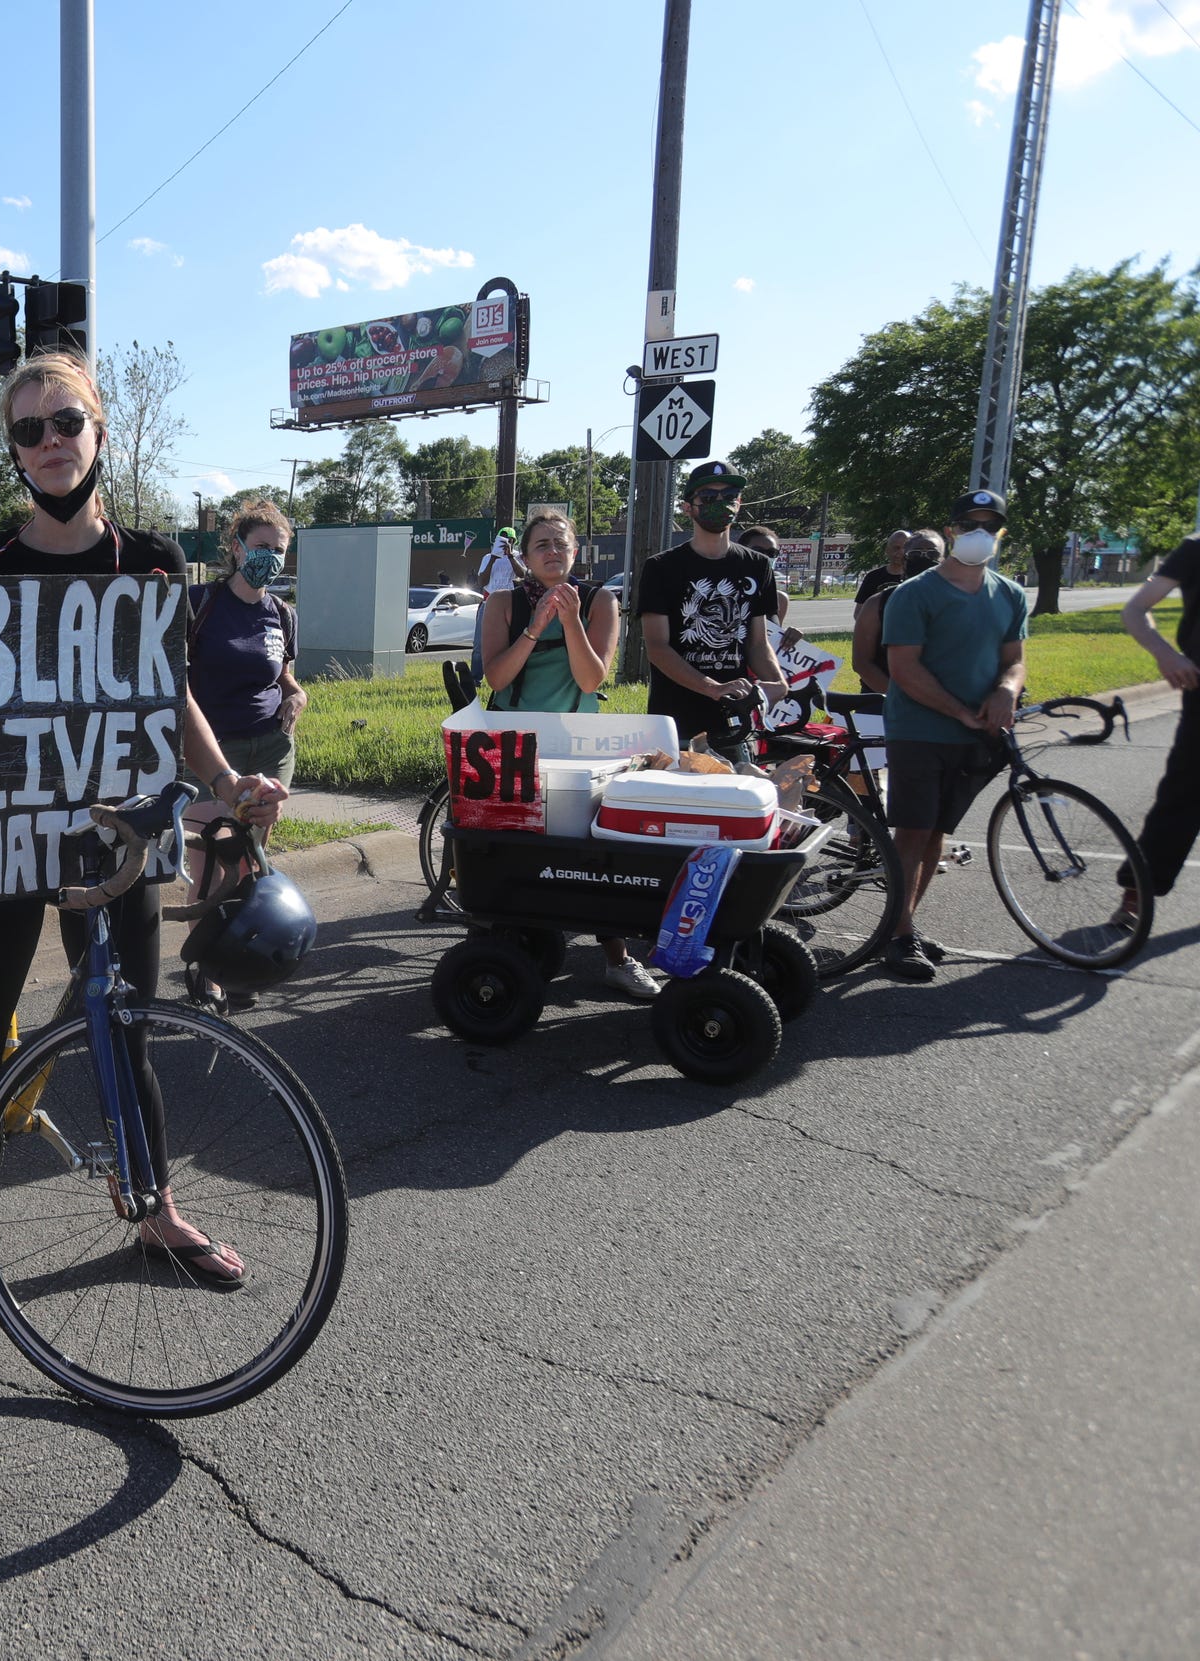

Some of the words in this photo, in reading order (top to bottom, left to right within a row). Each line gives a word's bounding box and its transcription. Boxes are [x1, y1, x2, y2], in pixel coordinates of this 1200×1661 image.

[297, 368, 311, 380] Up
[313, 367, 323, 376] to
[325, 361, 347, 374] 25%
[349, 358, 364, 370] off
[366, 352, 407, 370] grocery
[409, 348, 438, 361] store
[653, 345, 709, 371] WEST
[297, 379, 329, 392] prices.
[331, 374, 351, 386] Hip,
[353, 371, 369, 382] hip
[371, 364, 411, 378] hooray!
[668, 396, 685, 410] M
[656, 411, 694, 441] 102
[438, 527, 463, 544] Bar
[555, 869, 610, 883] GORILLA
[613, 874, 660, 887] CARTS
